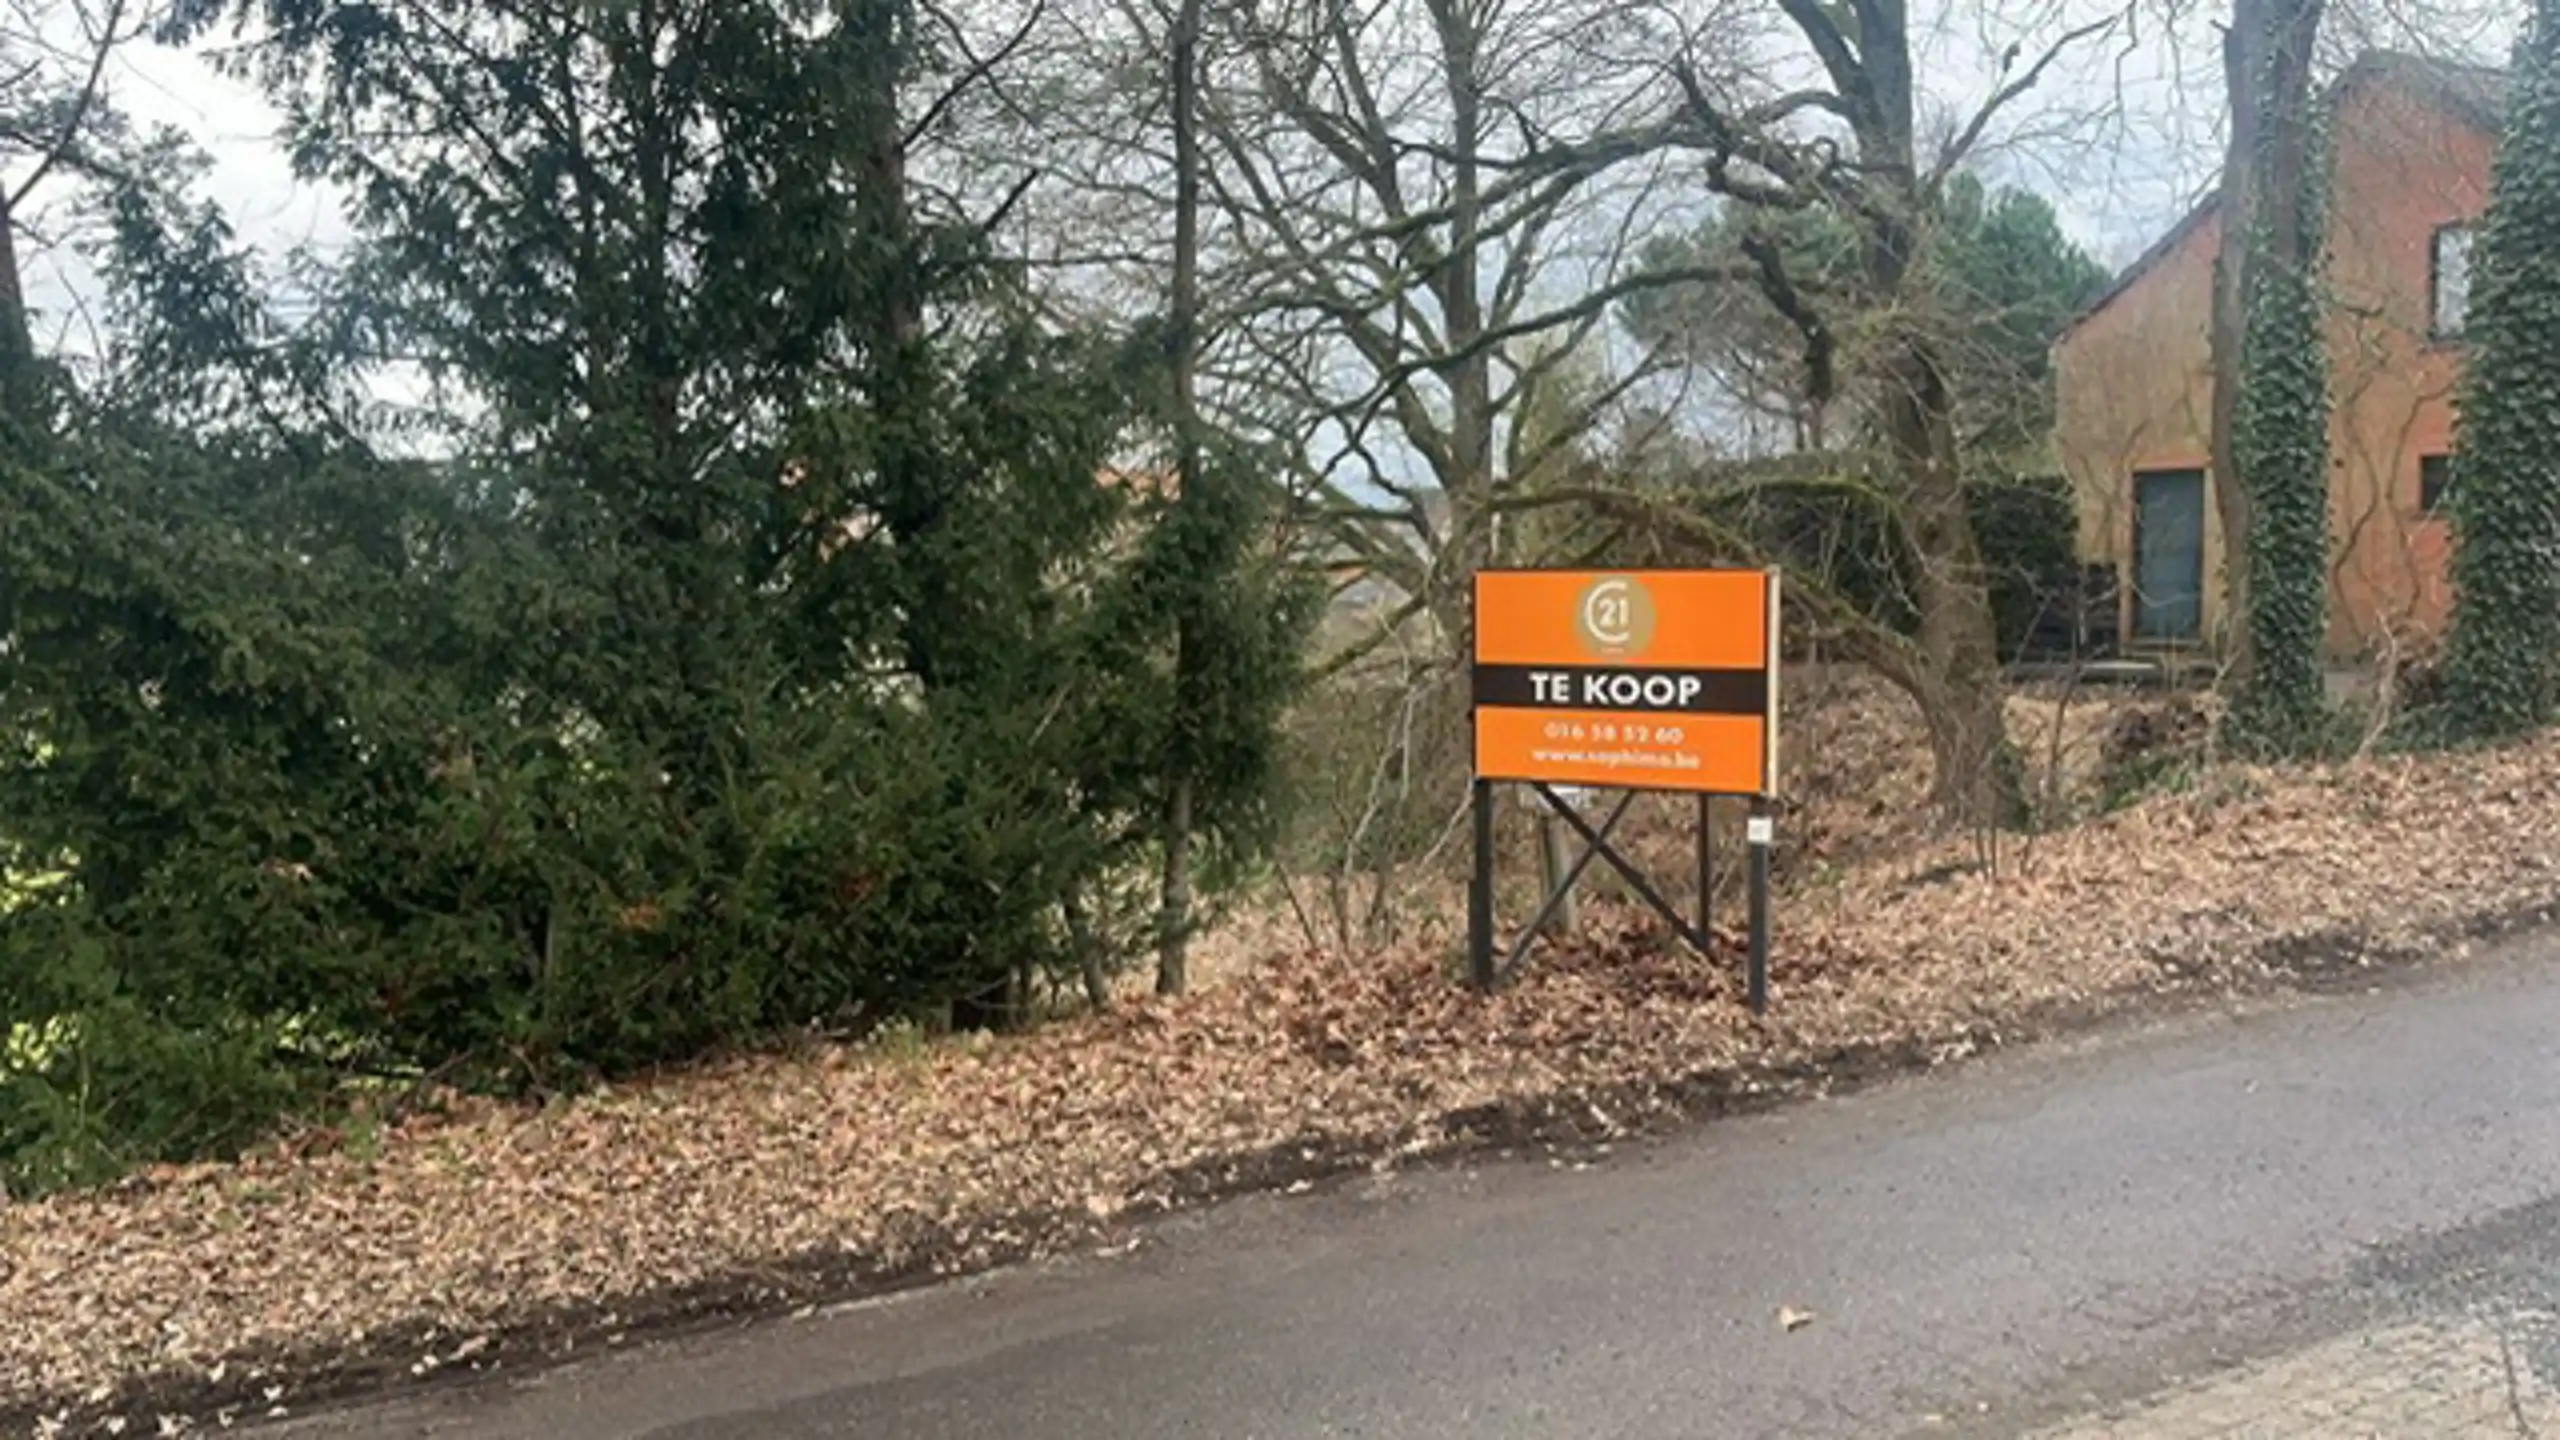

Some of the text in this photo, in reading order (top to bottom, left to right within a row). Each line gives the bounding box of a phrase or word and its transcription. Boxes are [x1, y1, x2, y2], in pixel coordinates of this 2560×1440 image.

[1529, 672, 1701, 706] TE KOOP
[1543, 721, 1585, 741] 016
[1655, 726, 1685, 746] 60
